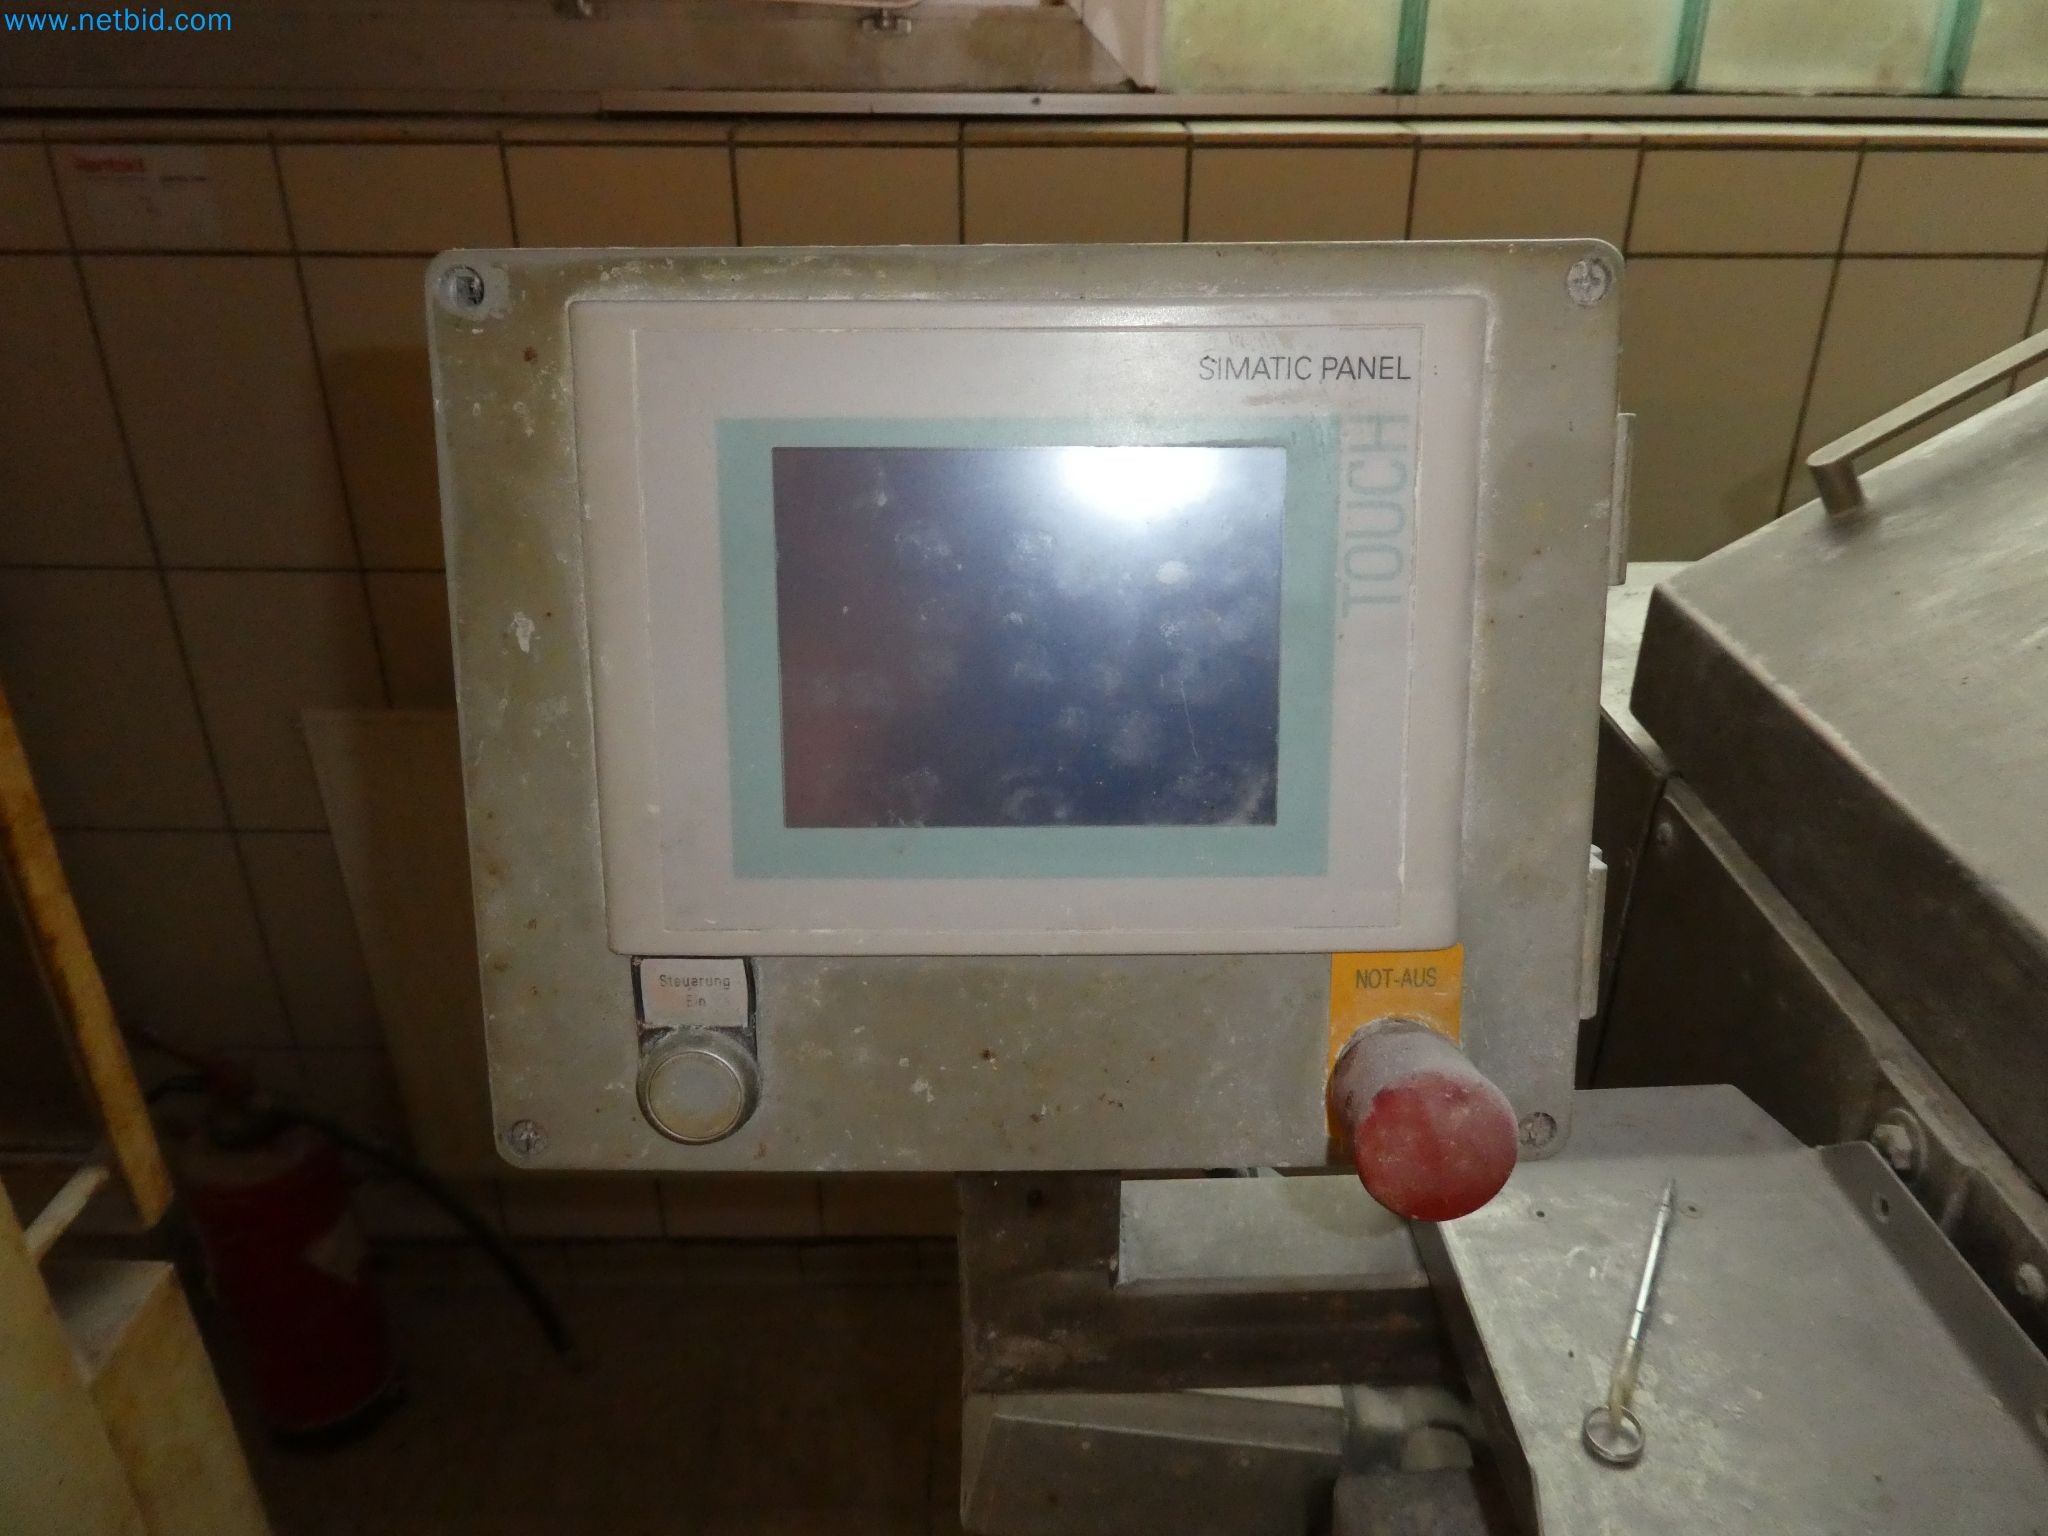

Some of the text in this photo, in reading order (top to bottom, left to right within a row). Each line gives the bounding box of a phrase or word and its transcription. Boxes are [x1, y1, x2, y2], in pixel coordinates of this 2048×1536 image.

[1199, 354, 1412, 381] SIMATIC PANEL
[1341, 413, 1410, 619] TOUCH
[659, 973, 731, 990] Steuerung
[1355, 966, 1438, 989] NOT-AUS
